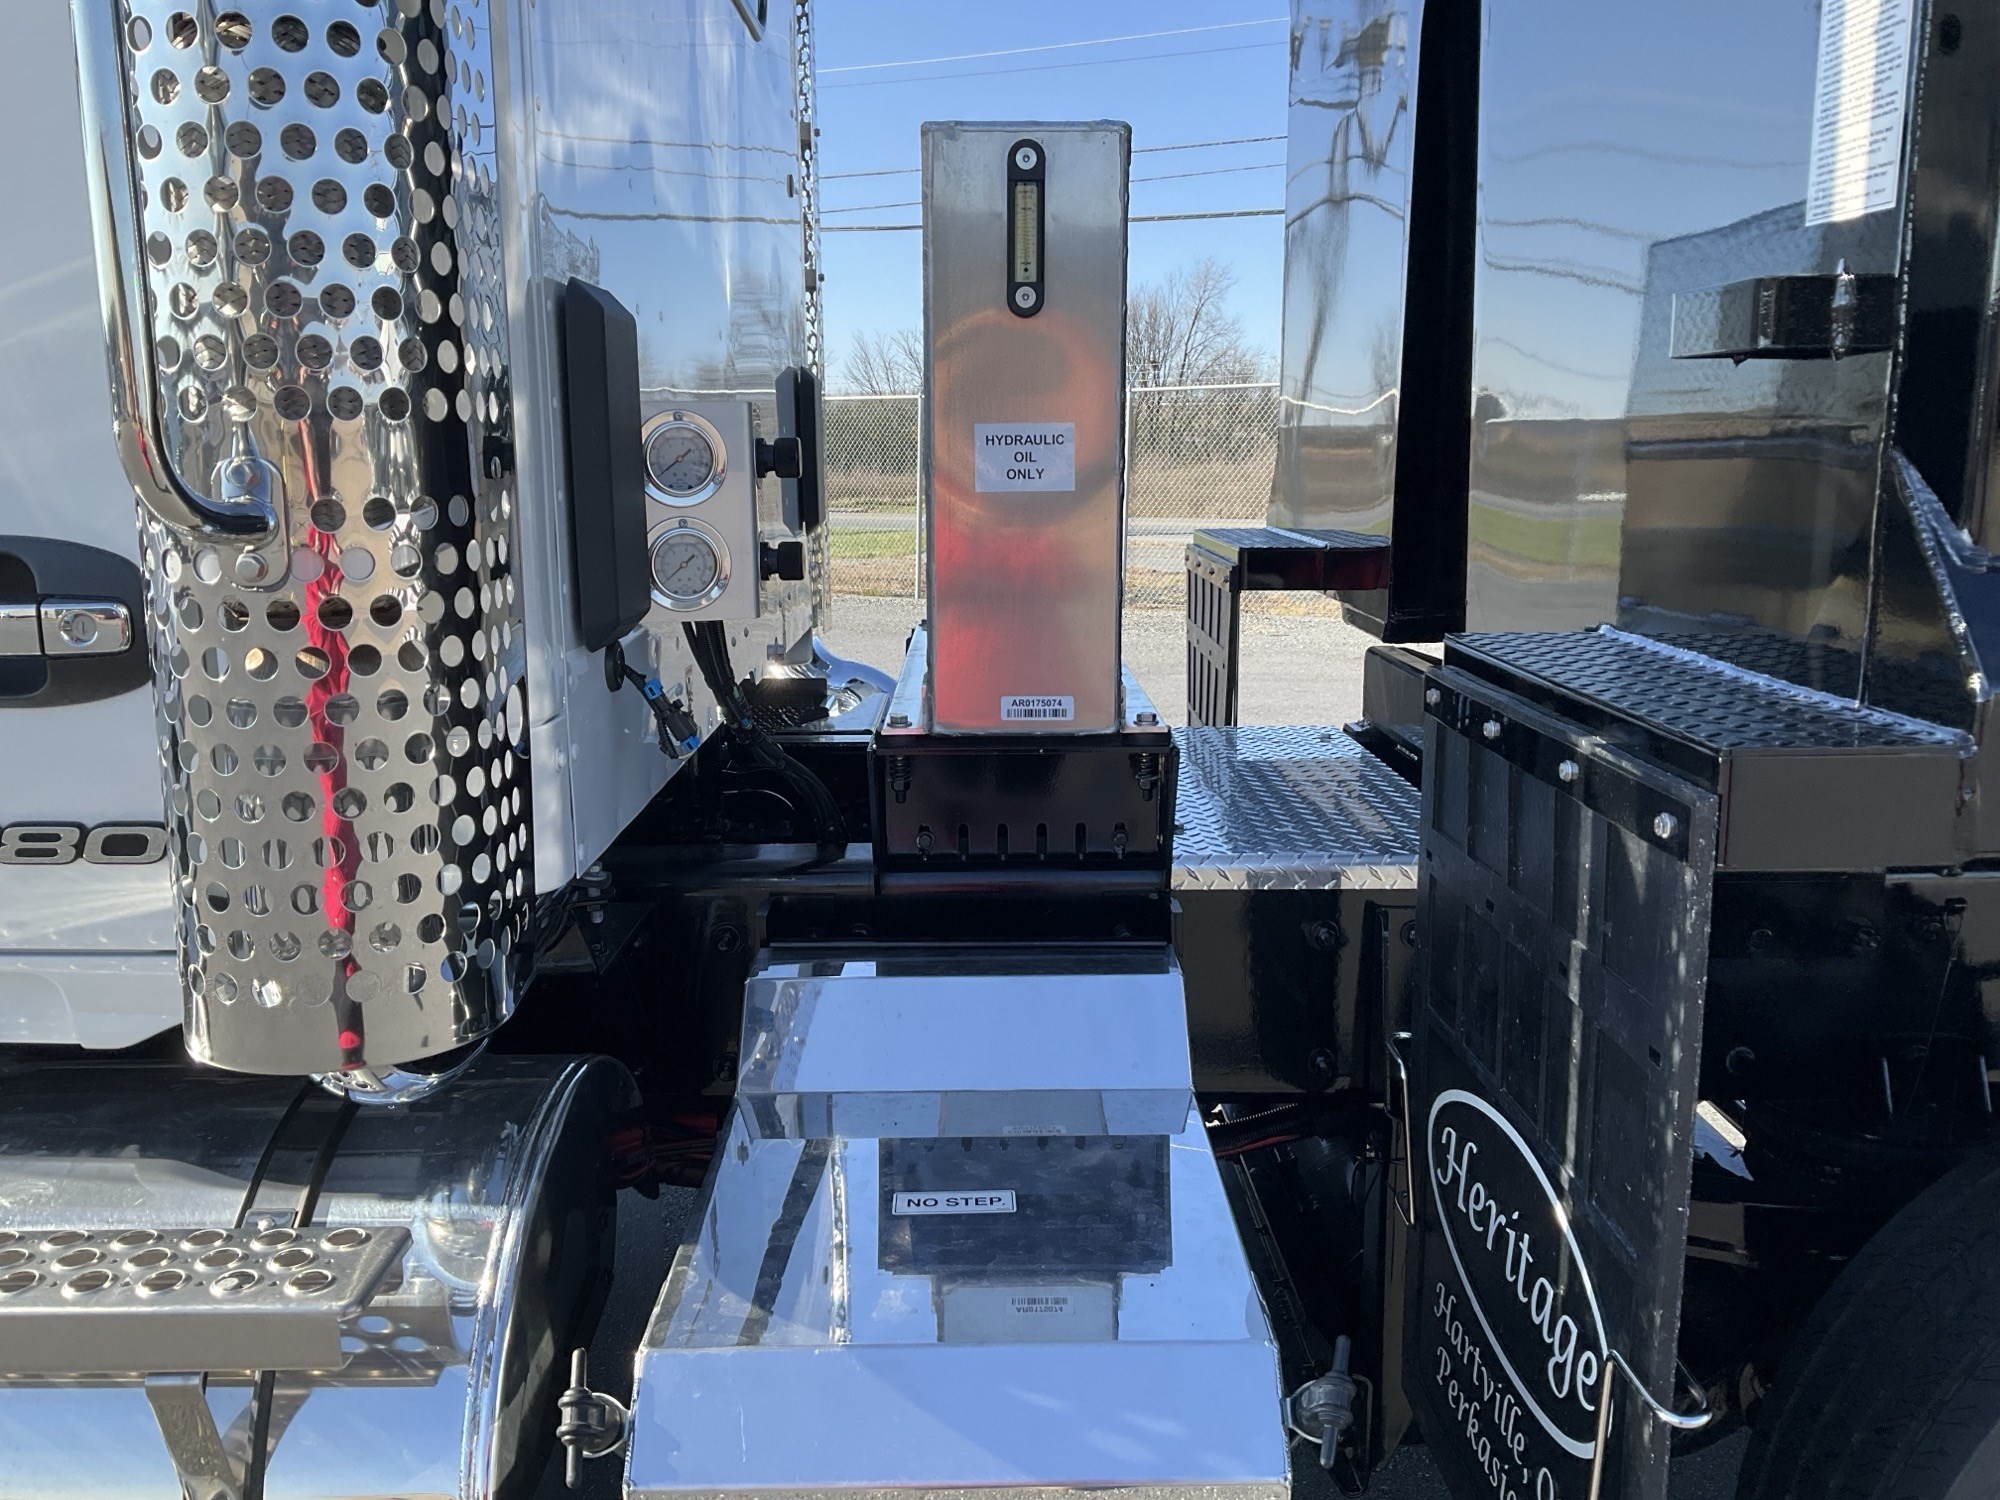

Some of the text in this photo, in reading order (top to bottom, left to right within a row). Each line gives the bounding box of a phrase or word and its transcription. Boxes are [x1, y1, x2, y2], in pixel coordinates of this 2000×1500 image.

[985, 433, 1065, 446] HYDRAULIC
[1013, 451, 1037, 463] OIL
[1006, 468, 1045, 480] ONLY
[1011, 698, 1063, 708] AR0175074
[906, 1197, 939, 1208] NO
[1436, 1126, 1598, 1411] Heritage
